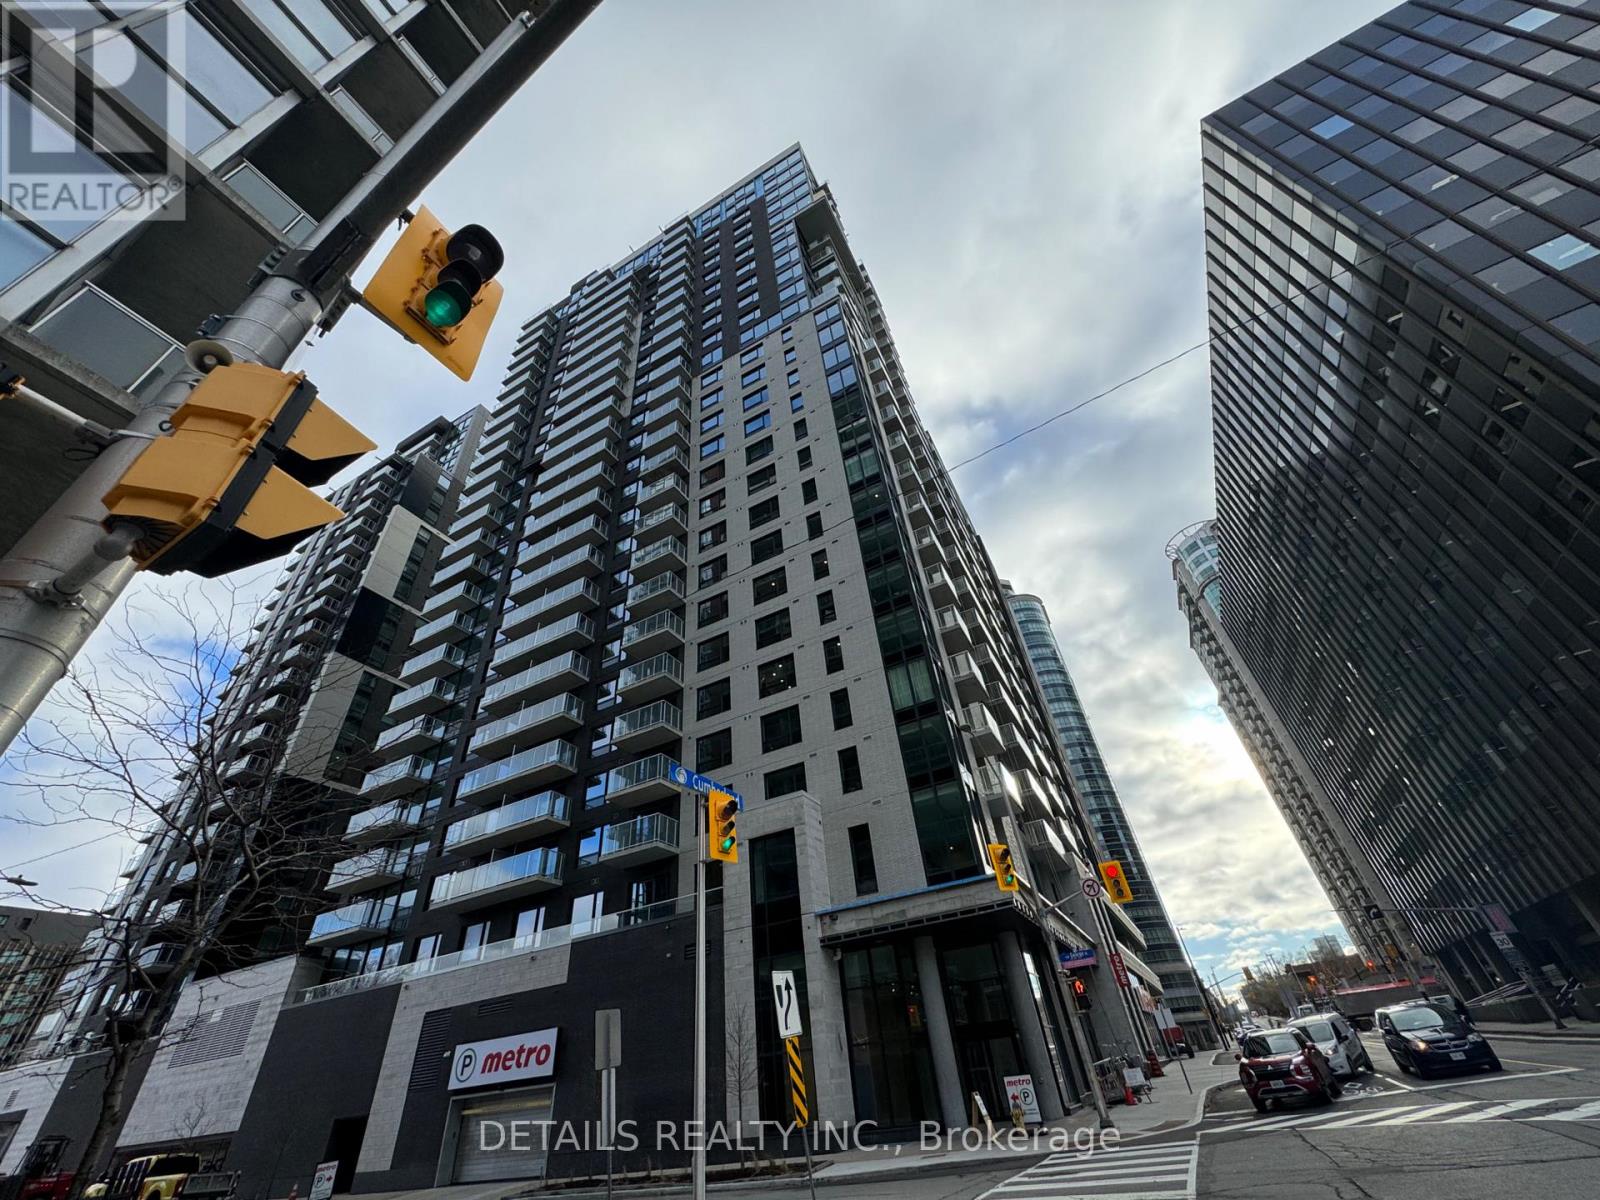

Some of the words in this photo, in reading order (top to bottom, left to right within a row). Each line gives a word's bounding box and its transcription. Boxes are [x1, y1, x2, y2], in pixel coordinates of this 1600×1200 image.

[1496, 938, 1510, 947] 30
[1113, 955, 1128, 984] metro
[460, 1054, 472, 1077] P
[480, 1043, 552, 1076] metro
[1006, 1078, 1031, 1087] metro
